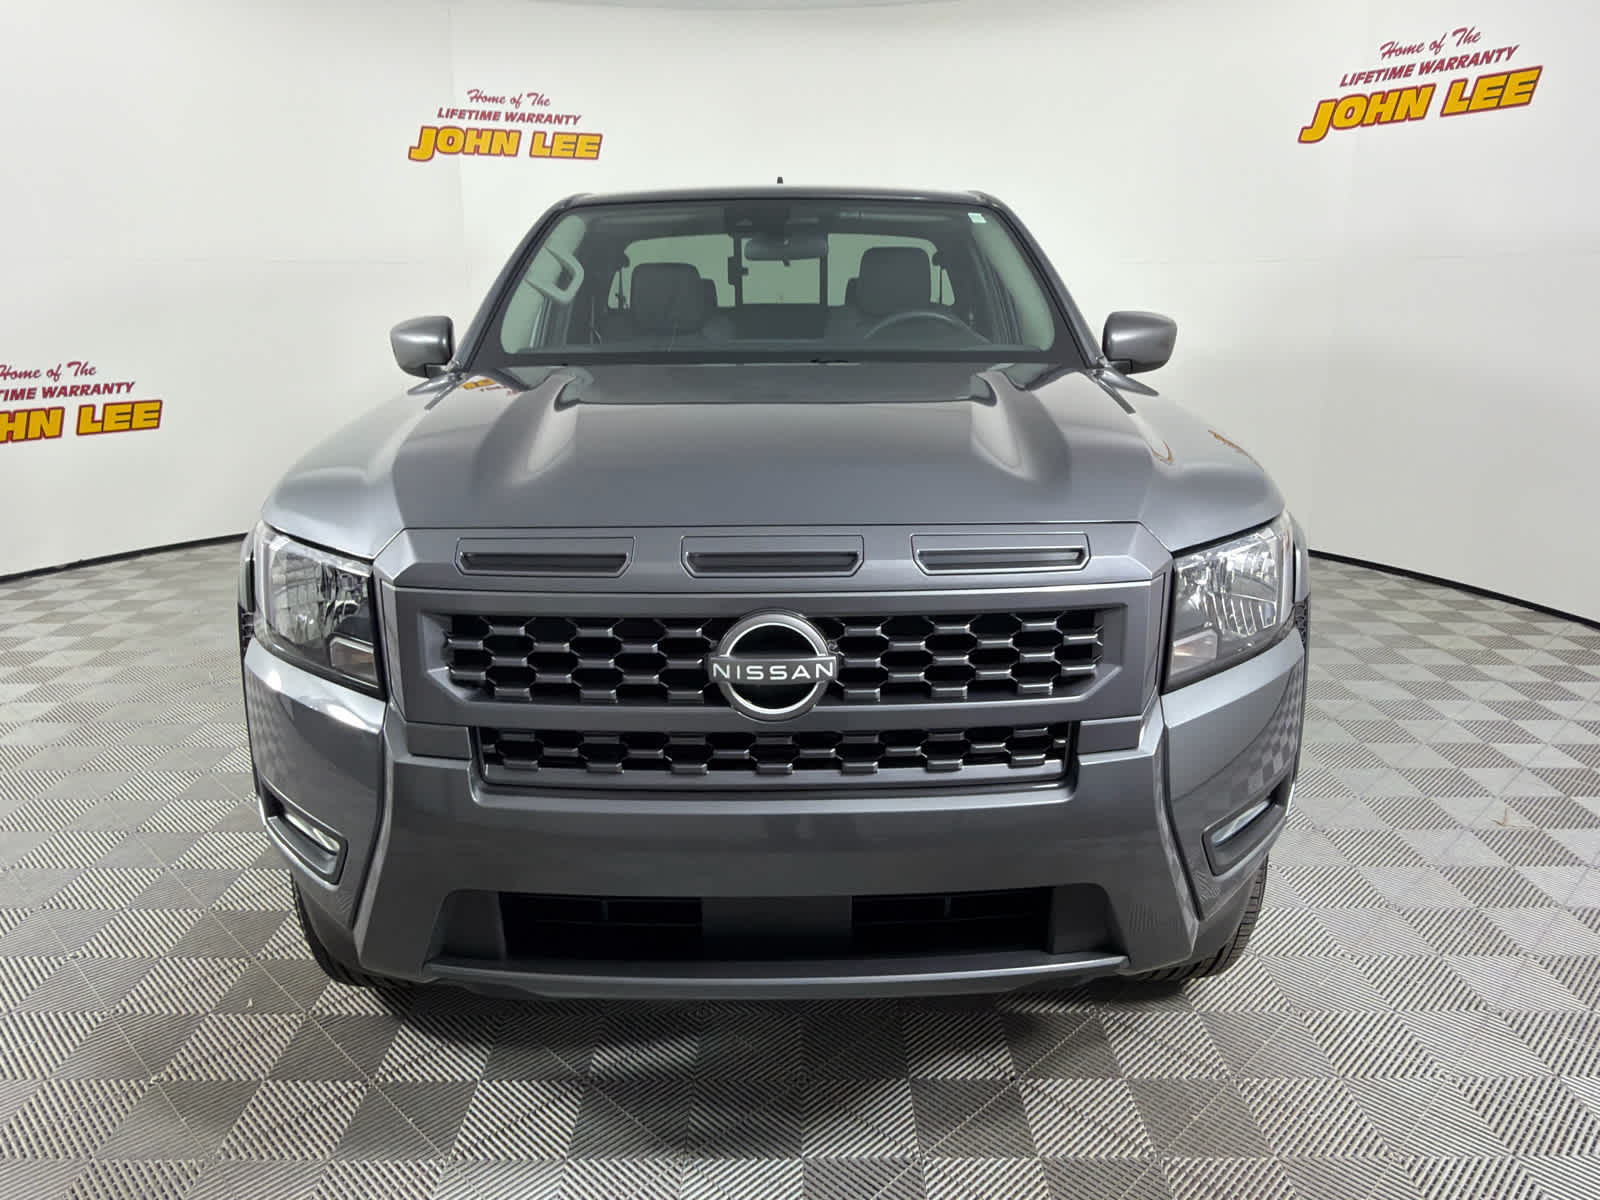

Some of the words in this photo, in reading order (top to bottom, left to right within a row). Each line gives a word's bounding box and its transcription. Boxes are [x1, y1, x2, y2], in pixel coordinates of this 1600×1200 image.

[1380, 41, 1424, 60] Home
[1428, 33, 1448, 56] of
[1452, 25, 1482, 47] The
[1339, 64, 1415, 88] LIFETIME
[1418, 45, 1520, 76] WARRANTY
[467, 89, 506, 105] Home
[509, 93, 523, 109] of
[527, 92, 551, 107] The
[1298, 83, 1437, 144] JOHN
[1440, 65, 1543, 117] LEE
[437, 107, 501, 121] LIFETIME
[504, 111, 582, 126] WARRANTY
[408, 125, 522, 162] JOHN
[529, 130, 603, 160] LEE
[46, 363, 62, 382] of
[67, 361, 97, 377] The
[42, 382, 135, 399] WARRANTY
[76, 399, 163, 436] LEE
[712, 662, 834, 681] NISSAN
